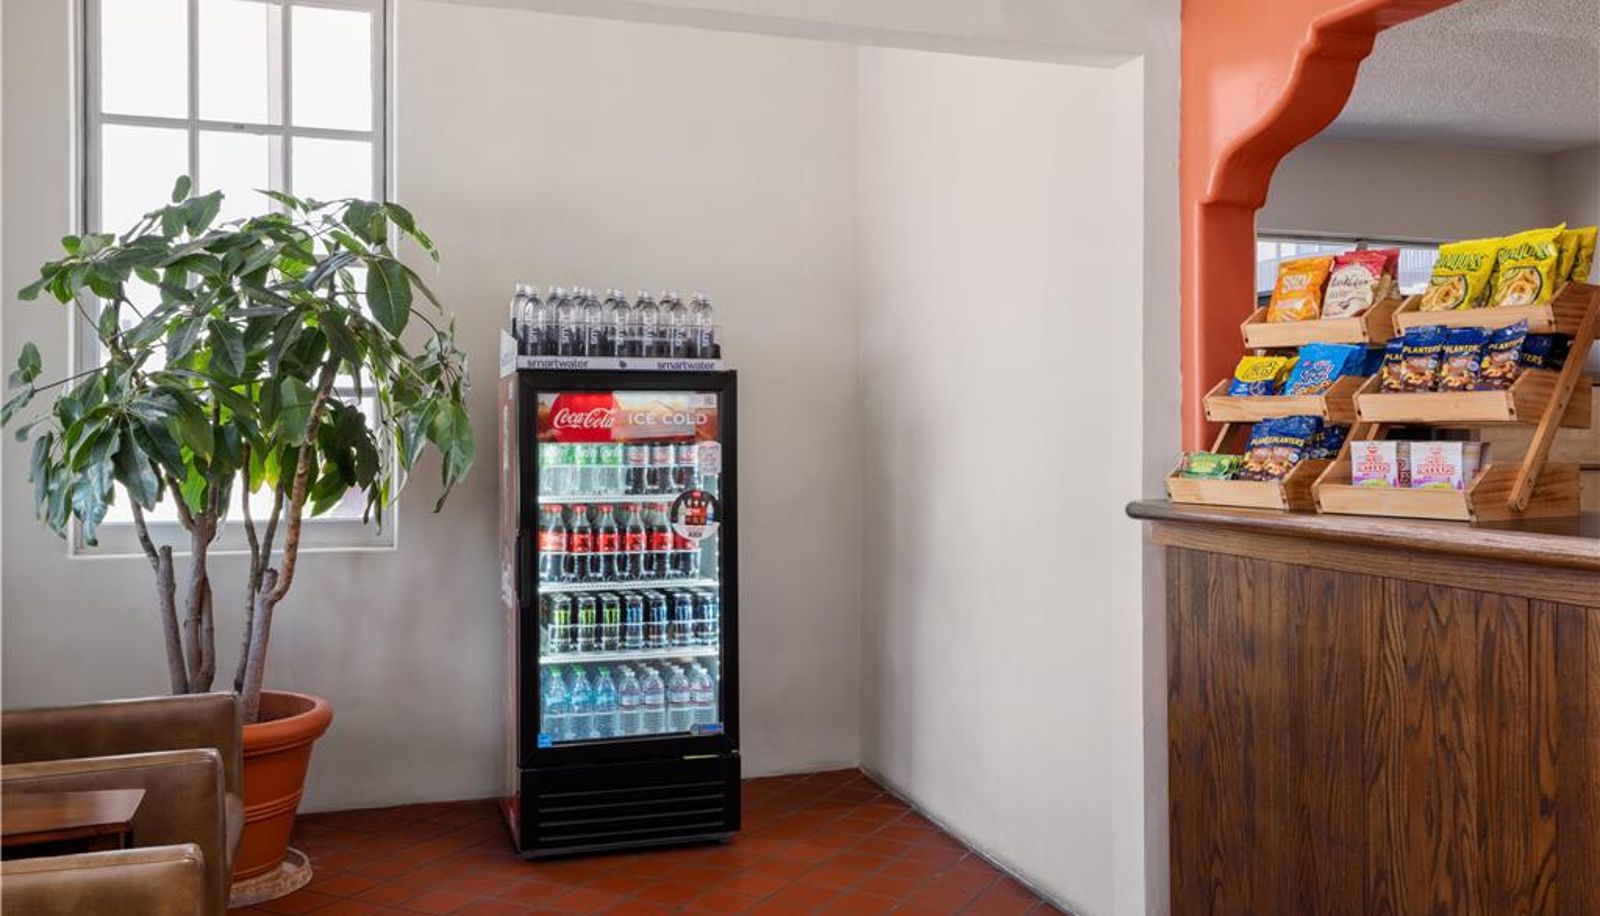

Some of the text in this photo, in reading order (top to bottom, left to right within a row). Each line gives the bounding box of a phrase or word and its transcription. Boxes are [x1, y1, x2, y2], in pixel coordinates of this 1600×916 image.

[1402, 344, 1443, 354] PLANTERS
[526, 359, 589, 369] smartwater
[656, 360, 716, 370] smartwater
[553, 407, 708, 430] Coca-Cola ICE COLD
